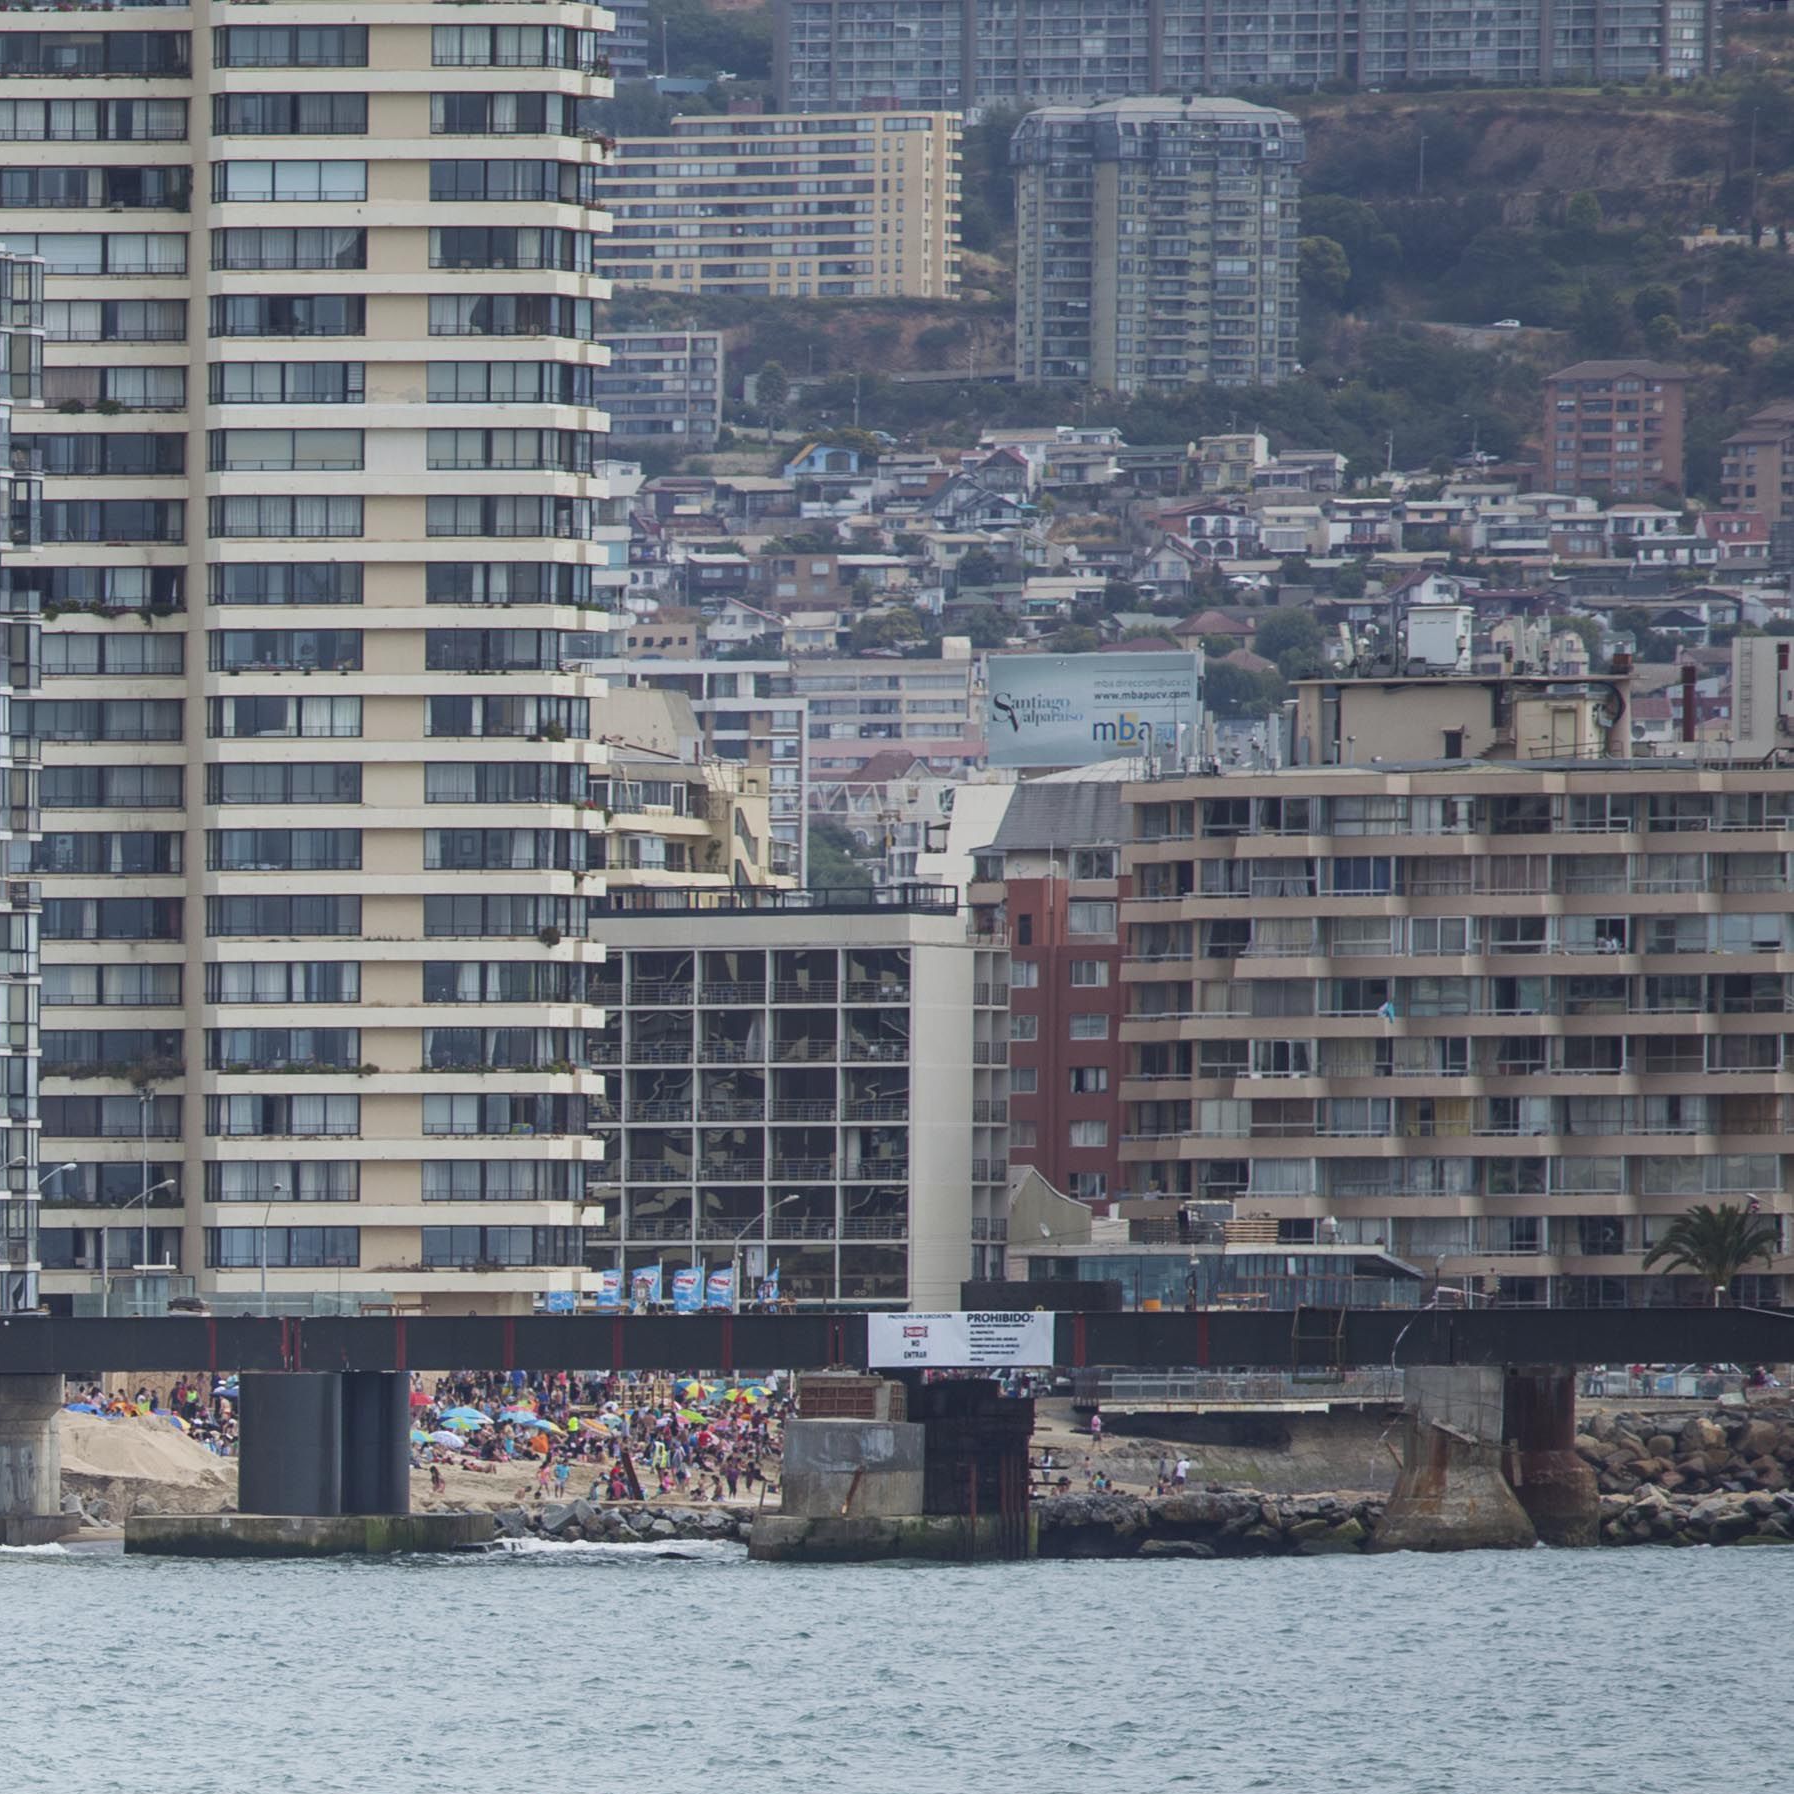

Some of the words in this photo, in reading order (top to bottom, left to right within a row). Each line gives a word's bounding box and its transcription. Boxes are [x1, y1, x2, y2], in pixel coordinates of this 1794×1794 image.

[1094, 690, 1191, 702] www.mbapucv.com
[992, 692, 1071, 722] Santiago
[1093, 713, 1152, 741] mba
[966, 1312, 1035, 1323] PROHIBIDO:
[903, 1350, 928, 1359] ENTRAR
